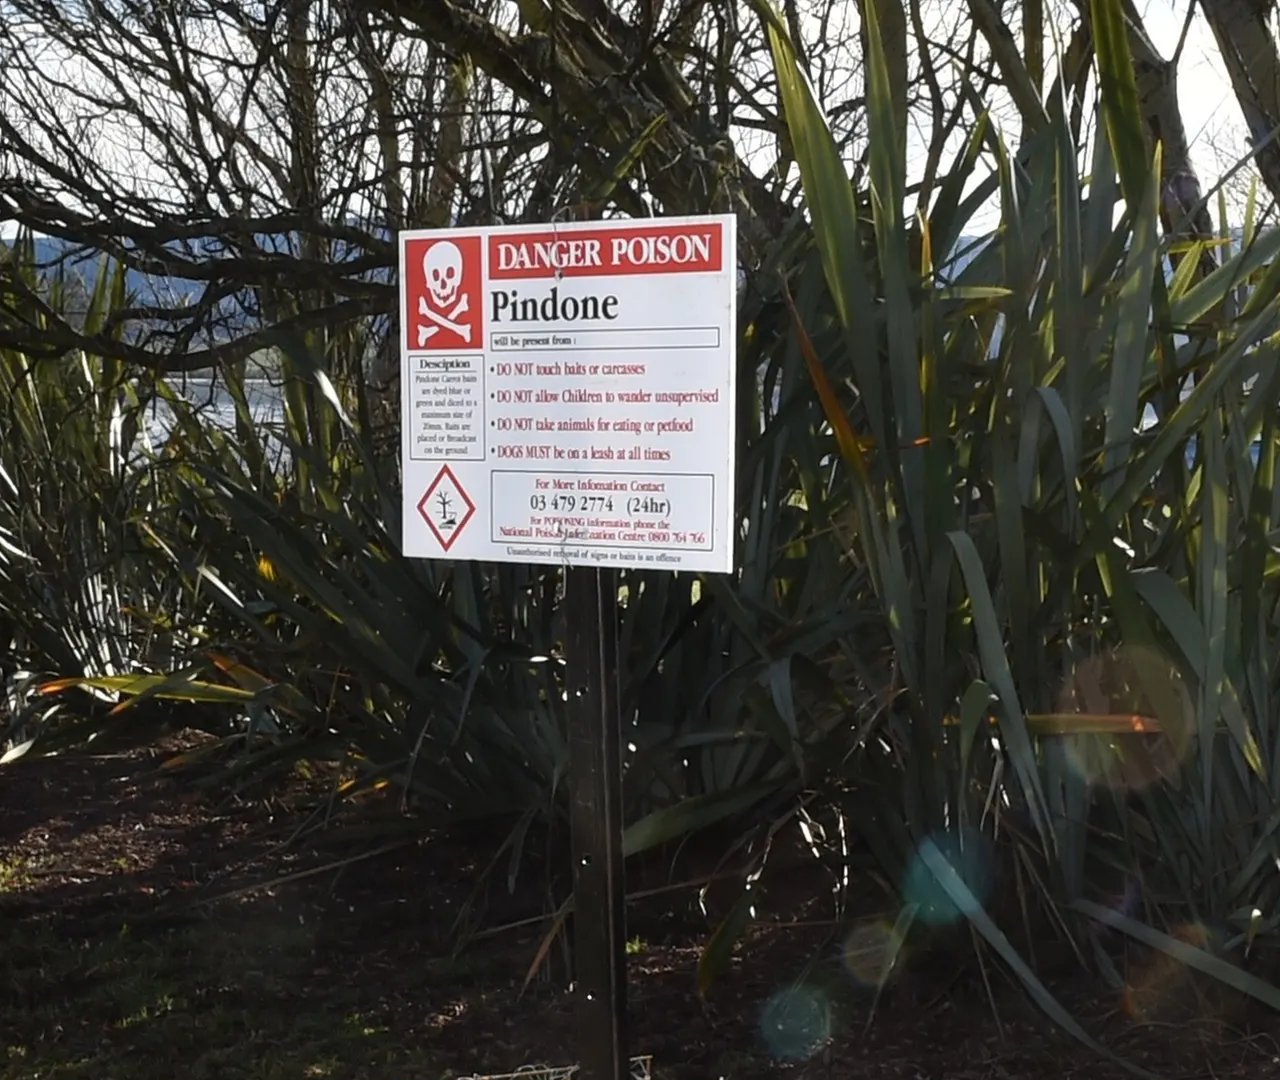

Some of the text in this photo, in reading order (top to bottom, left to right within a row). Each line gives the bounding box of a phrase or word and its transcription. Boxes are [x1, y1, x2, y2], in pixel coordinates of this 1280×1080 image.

[498, 234, 711, 270] DANGER POISON
[491, 287, 618, 322] Pindone
[494, 337, 507, 346] will
[511, 337, 519, 345] be
[523, 337, 550, 346] present
[552, 335, 571, 345] from
[420, 359, 470, 370] Desciption
[497, 361, 645, 376] DO NOT touch baits or carcasses
[498, 389, 719, 406] DO NOT allow Children to wander unsupervised
[498, 418, 693, 435] DO NOT take animals for eating or petfood
[417, 435, 436, 443] placed
[498, 446, 671, 460] DOGS MUST be on a leash at all times
[536, 479, 549, 489] For
[553, 479, 575, 490] More
[631, 481, 665, 492] Contact
[530, 495, 671, 517] 03 479 2774 (24hr)
[530, 516, 670, 530] For POISONING Information phone the
[500, 526, 532, 538] National
[535, 527, 562, 538] Poison
[618, 530, 646, 542] Centre
[648, 531, 669, 543] 0800
[507, 547, 551, 557] Unauthorised
[553, 547, 579, 559] removal
[581, 548, 588, 559] of
[590, 550, 609, 561] signs
[611, 552, 617, 560] or
[619, 551, 635, 560] baits
[638, 552, 643, 561] is
[656, 553, 681, 562] offence
